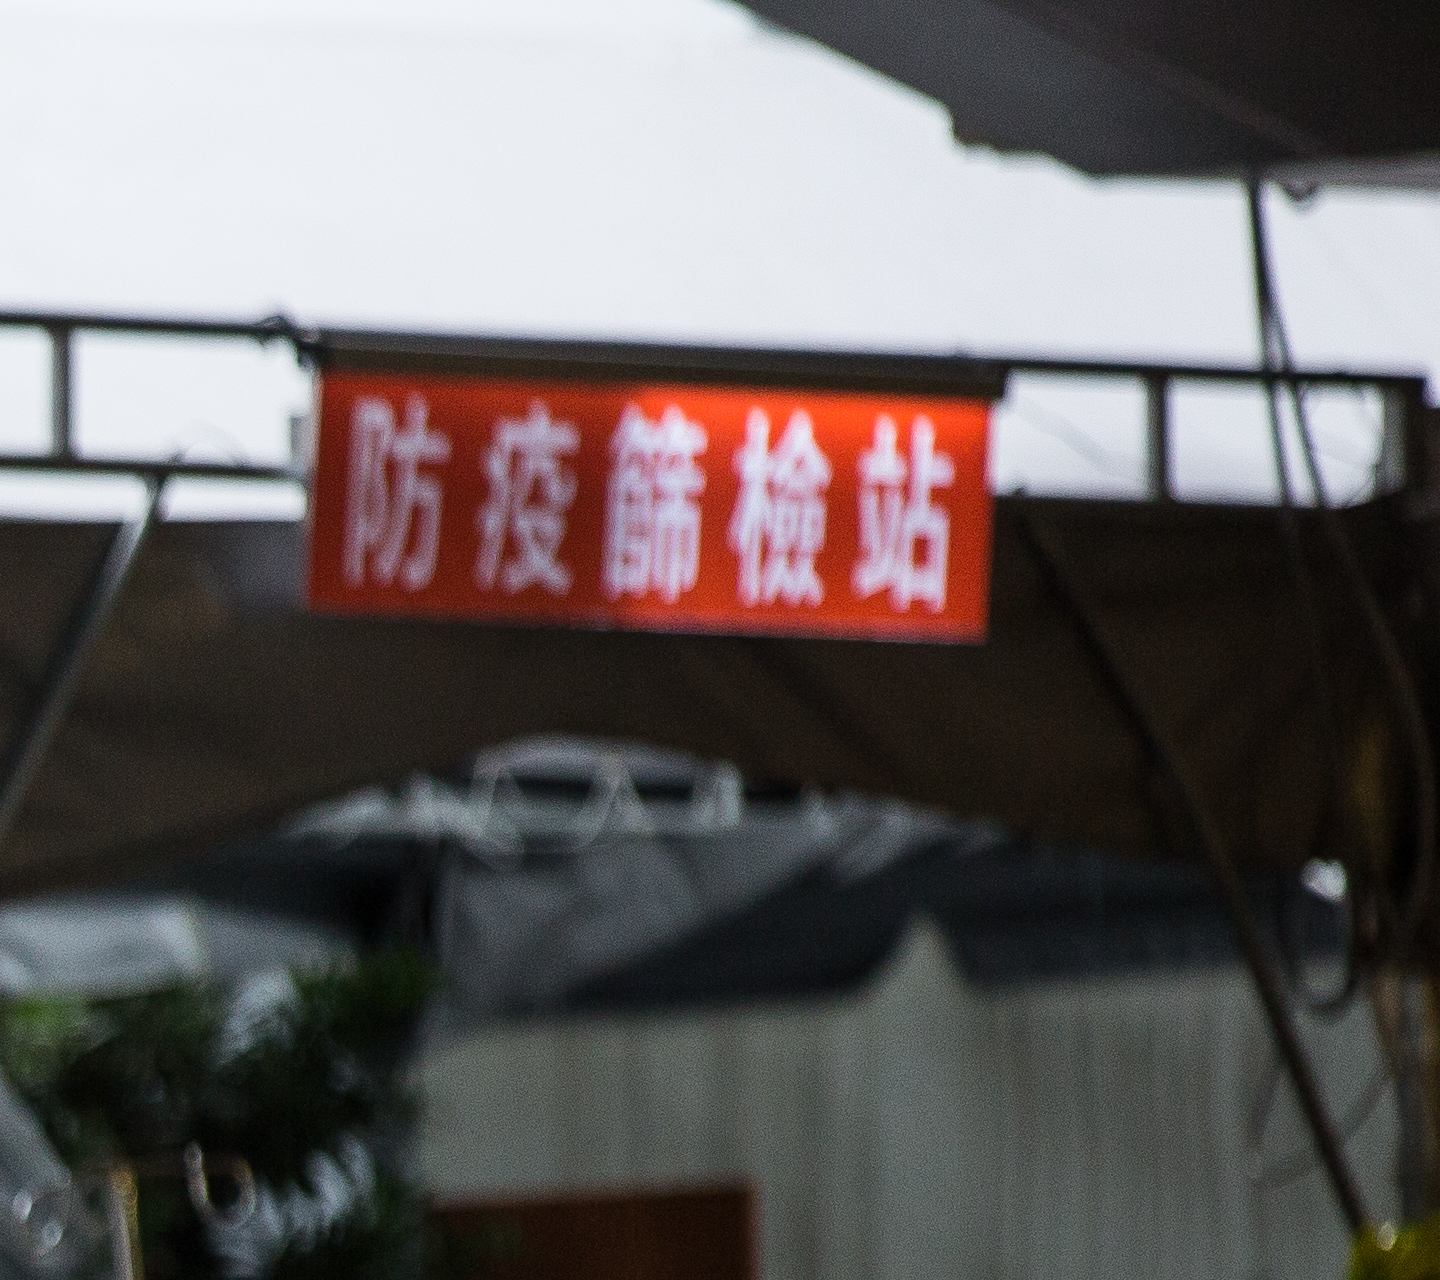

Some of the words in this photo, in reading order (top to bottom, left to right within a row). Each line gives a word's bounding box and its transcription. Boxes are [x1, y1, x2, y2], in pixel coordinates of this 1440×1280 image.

[343, 394, 956, 614] 防疫篩檢站
